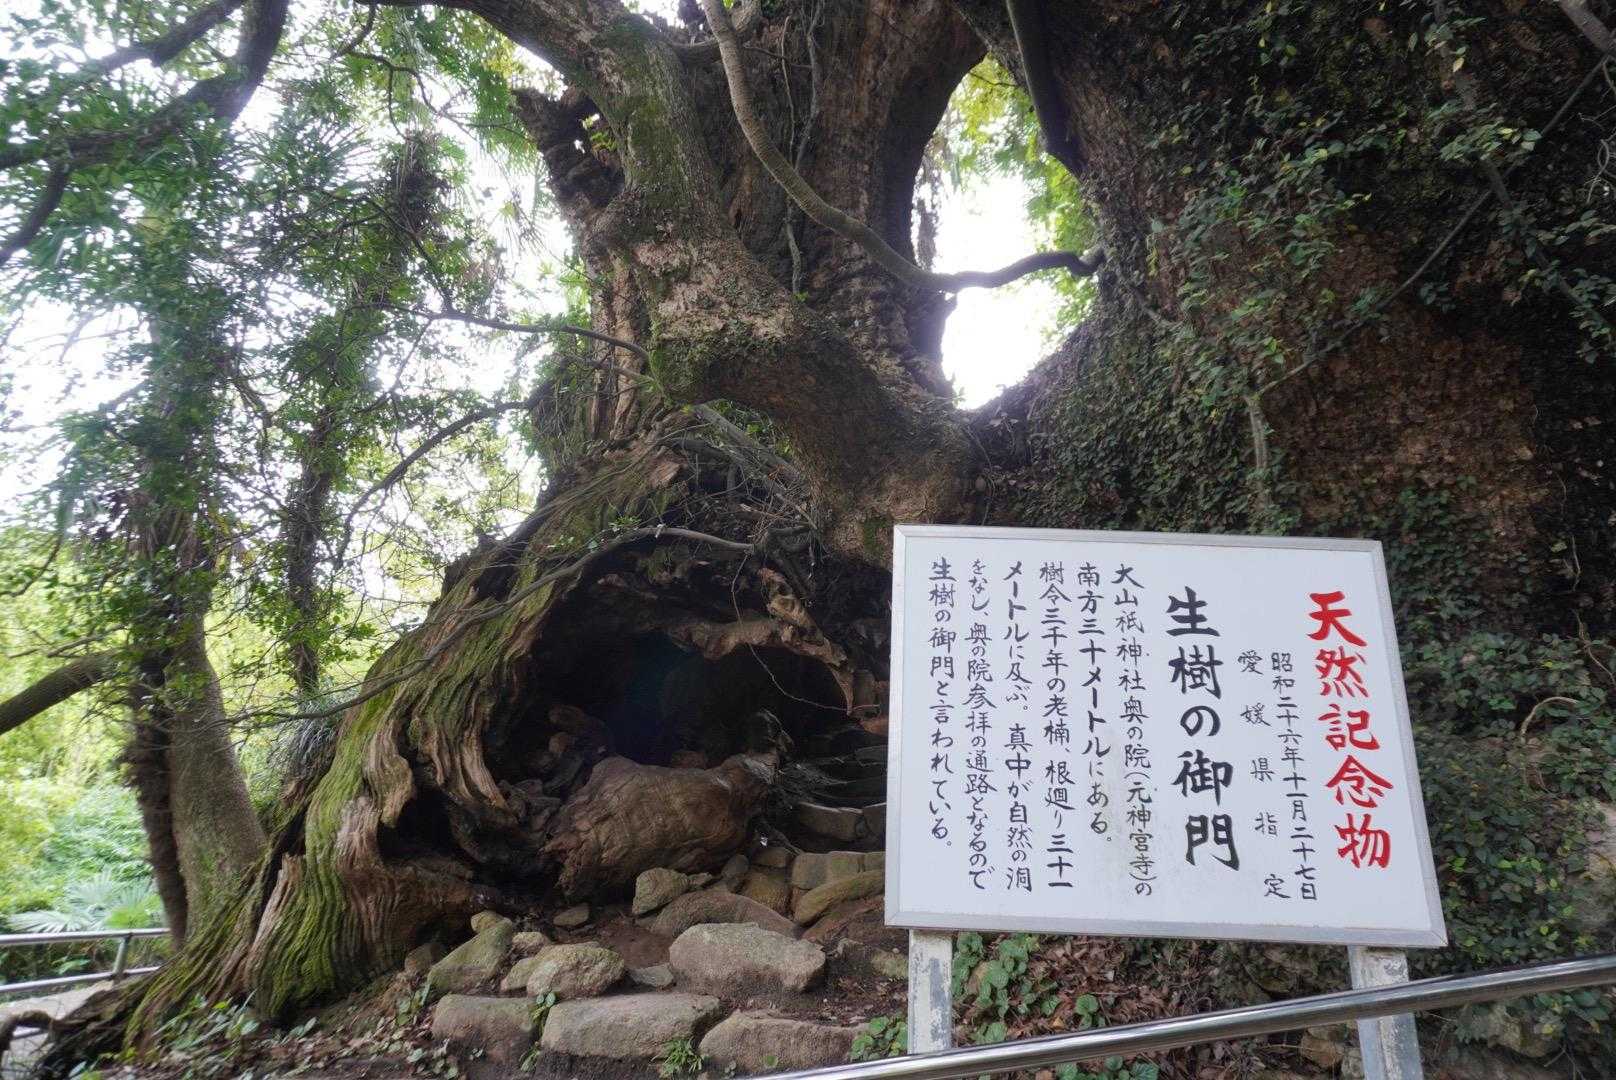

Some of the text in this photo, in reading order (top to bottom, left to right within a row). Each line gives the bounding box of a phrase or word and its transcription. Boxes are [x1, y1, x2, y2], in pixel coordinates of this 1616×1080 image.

[927, 556, 957, 846] 生樹の御門と言われている。
[962, 559, 997, 889] をなし、奥の院参拝の通路となるので
[1077, 562, 1111, 841] 南方三十メートルにある。
[1165, 586, 1240, 871] 生樹の御門
[1237, 650, 1291, 900] 愛媛県指定
[1271, 651, 1317, 901] 昭和二十六年十一月二十七日
[1307, 591, 1393, 868] 天然記念物
